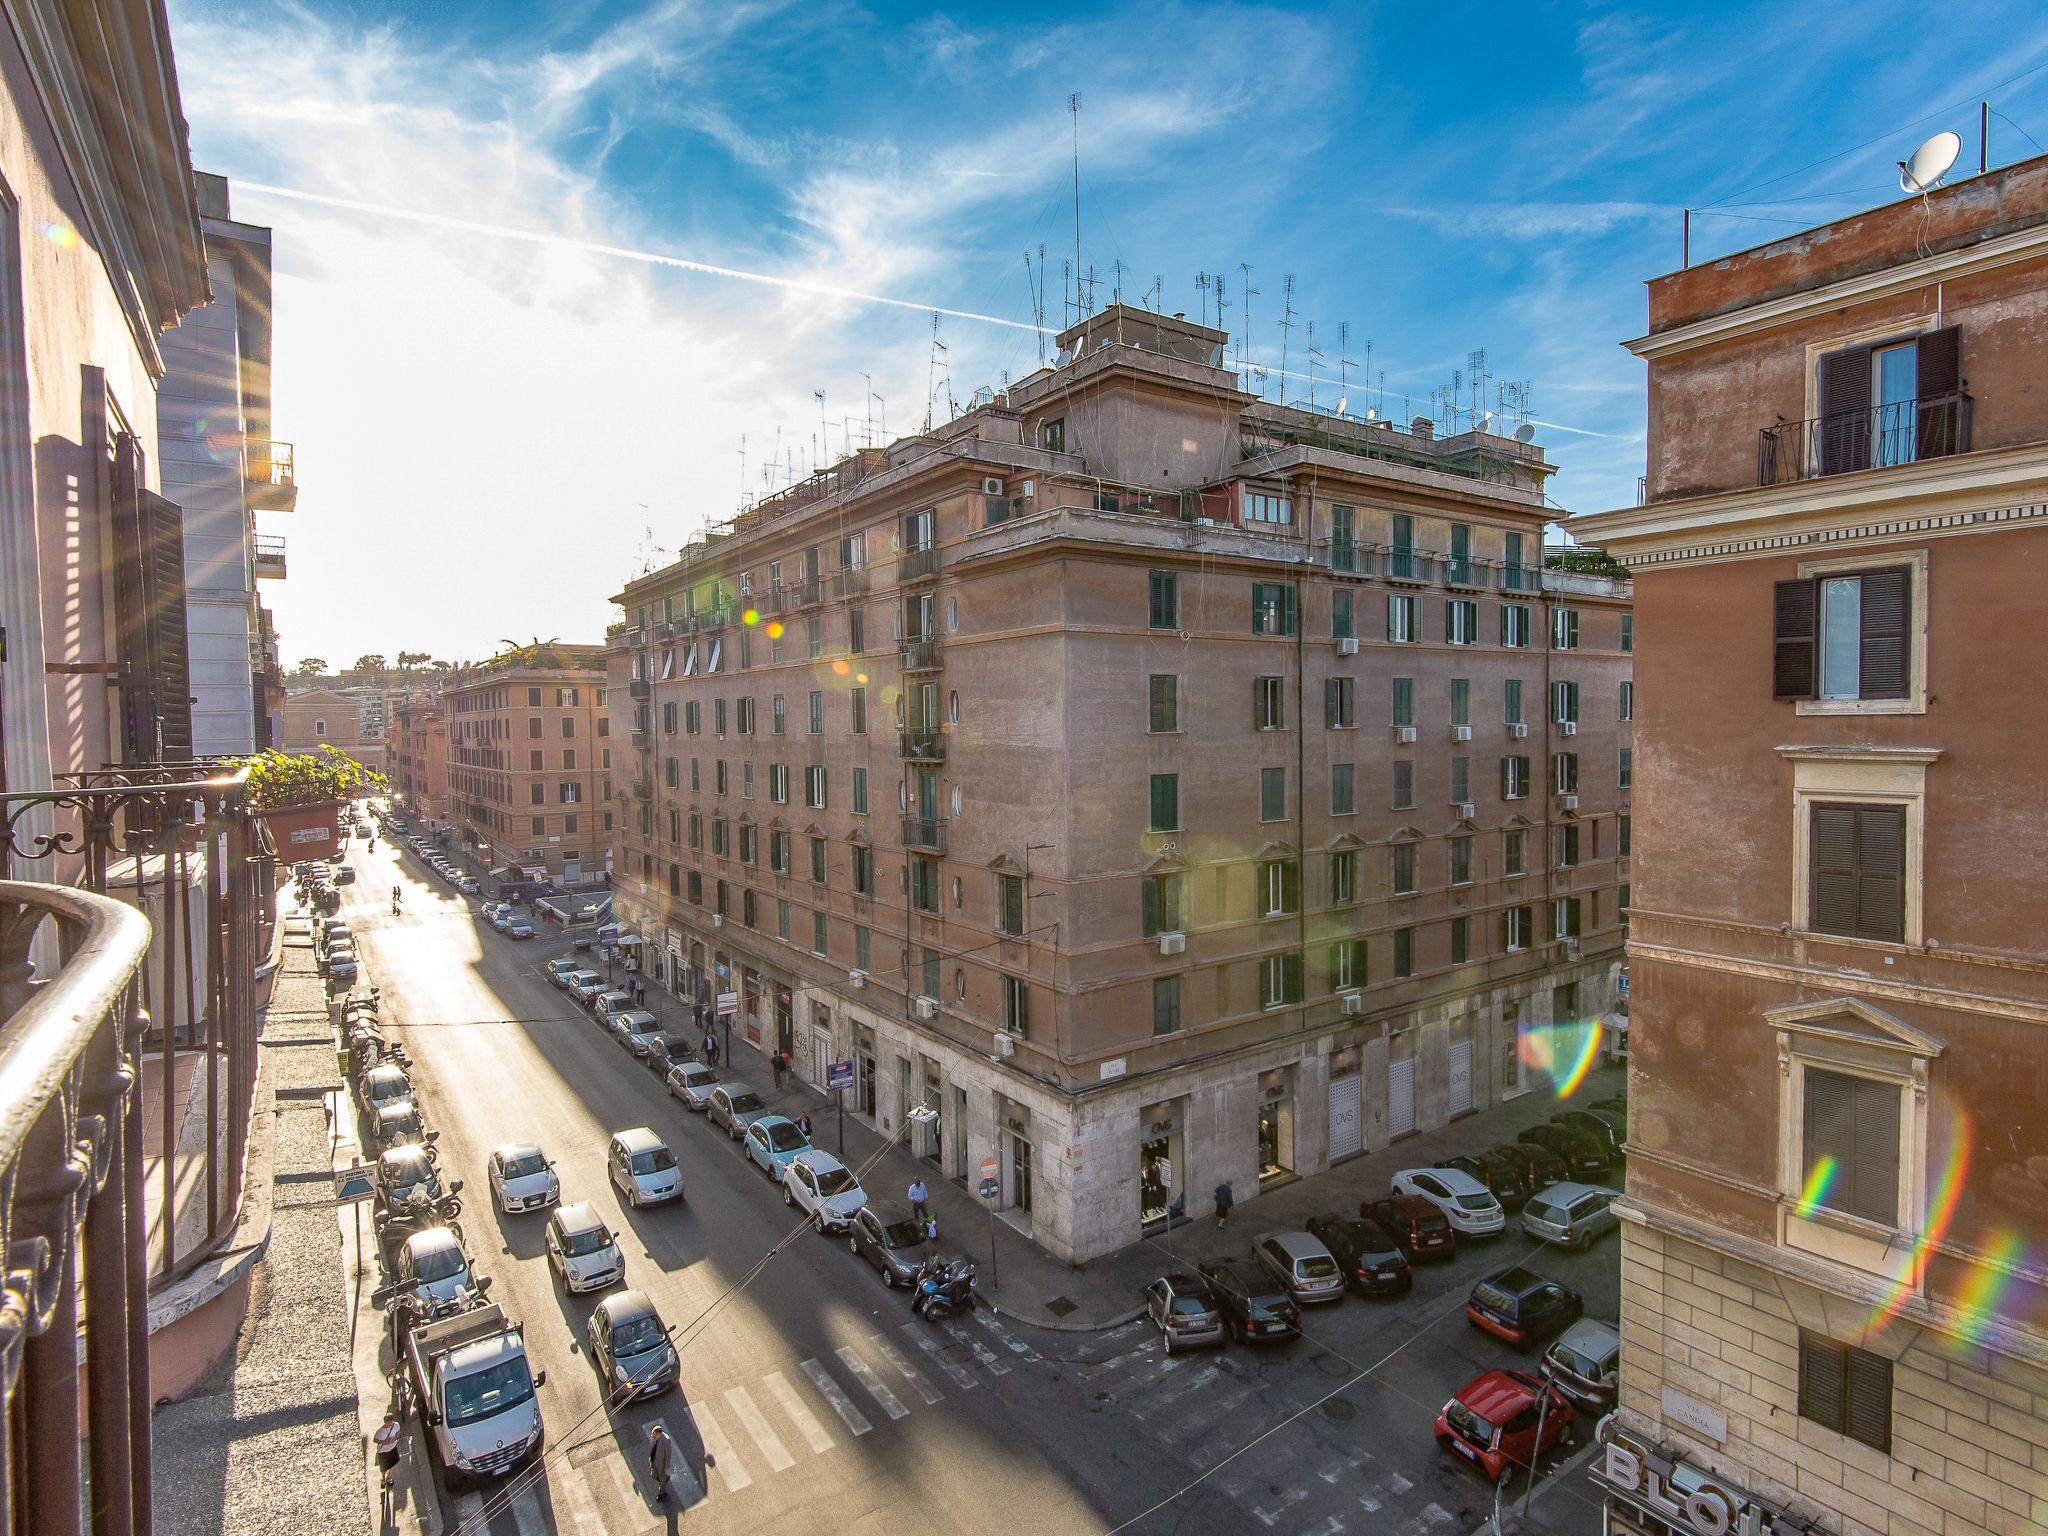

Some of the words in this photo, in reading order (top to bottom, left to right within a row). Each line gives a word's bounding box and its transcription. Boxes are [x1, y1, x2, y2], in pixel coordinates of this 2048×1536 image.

[1452, 1071, 1467, 1085] OVS
[1266, 1084, 1284, 1098] OVS
[1335, 1109, 1354, 1126] OVS
[1151, 1119, 1173, 1135] OVS
[345, 1170, 366, 1178] PISCINA
[1686, 1402, 1701, 1416] VIA
[1677, 1408, 1712, 1431] CANDIA
